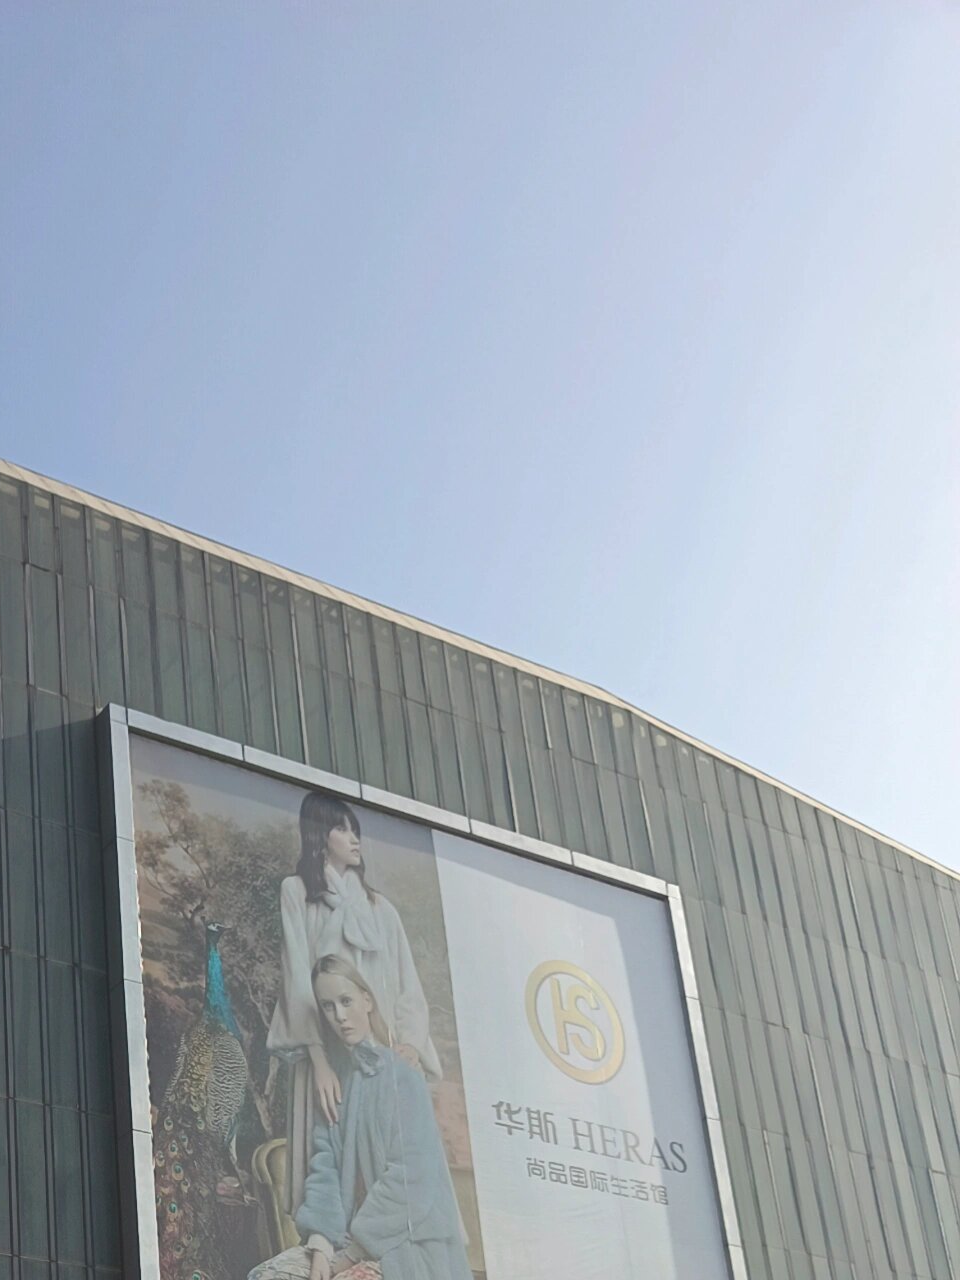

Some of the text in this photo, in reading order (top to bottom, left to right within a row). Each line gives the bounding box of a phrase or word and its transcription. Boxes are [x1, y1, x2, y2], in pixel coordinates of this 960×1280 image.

[491, 1100, 688, 1174] 华斯 HERAS
[526, 1156, 670, 1205] 尚品国际生活馆
